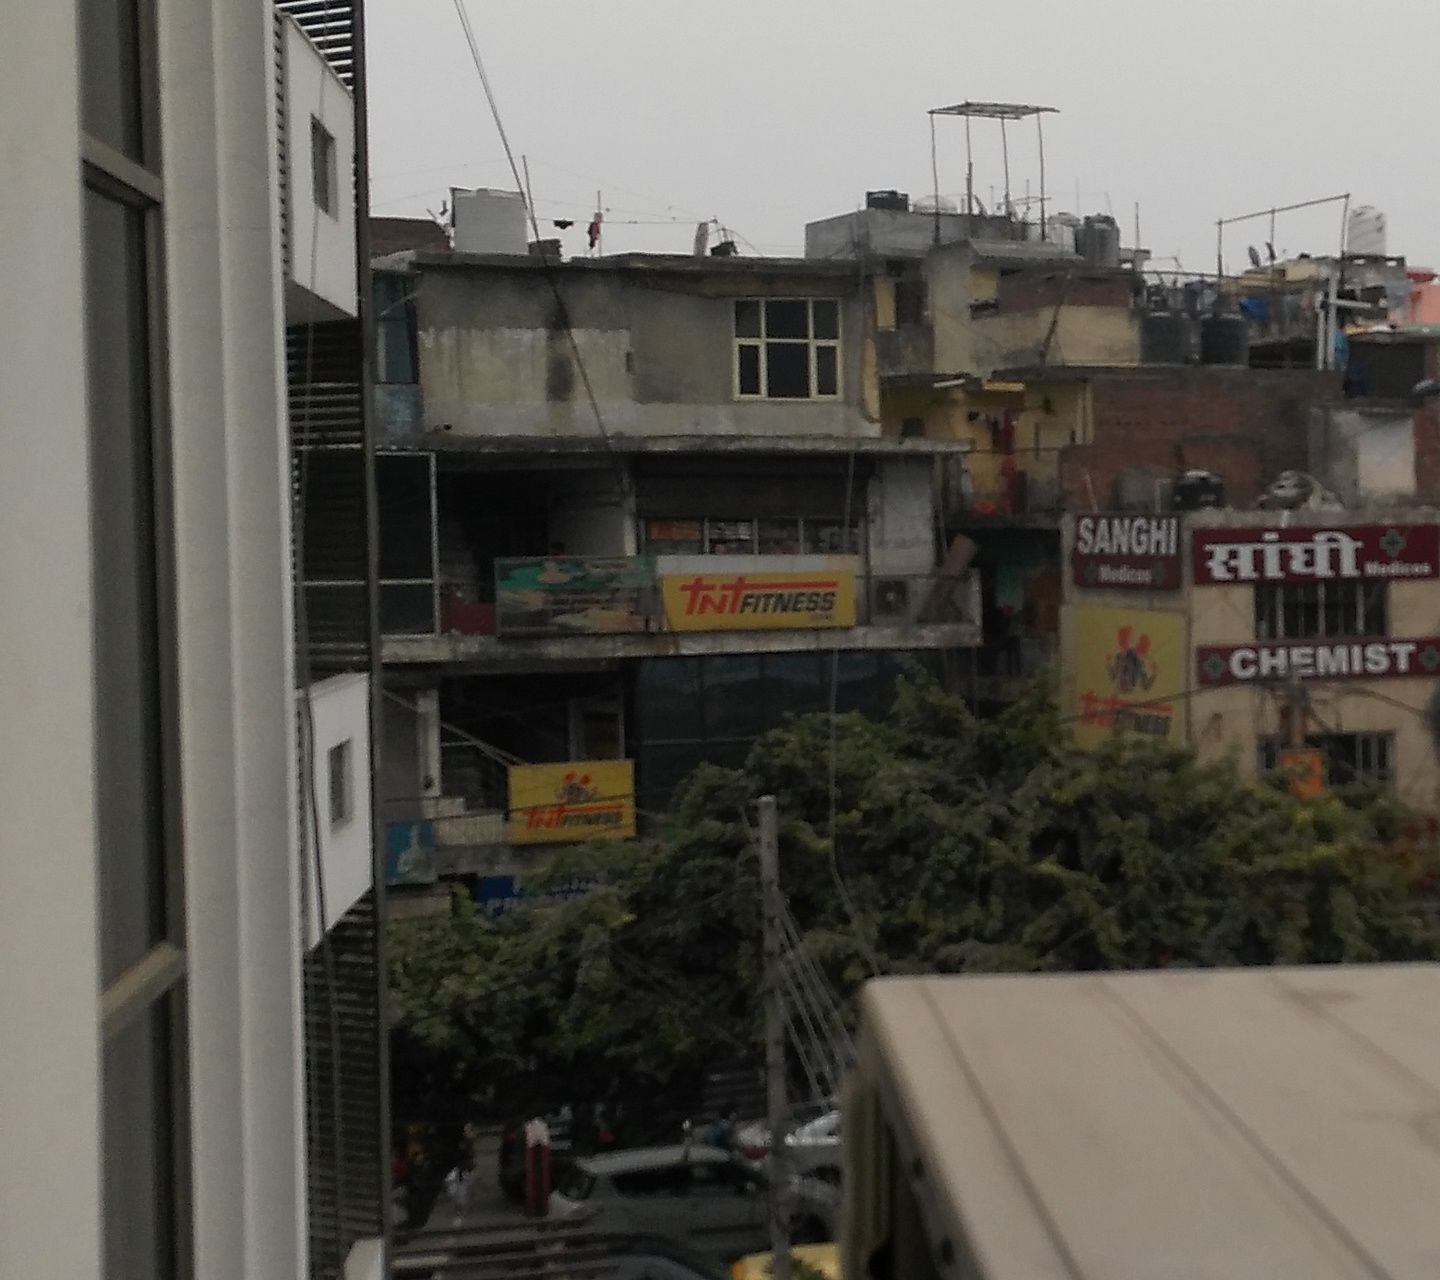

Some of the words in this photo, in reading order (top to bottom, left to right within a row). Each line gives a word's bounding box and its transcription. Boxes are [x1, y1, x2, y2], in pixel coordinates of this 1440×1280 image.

[1077, 516, 1177, 556] SANGHI
[1204, 530, 1363, 582] सांघी
[1364, 559, 1432, 578] Medicos
[740, 590, 838, 613] FITNESS
[1230, 641, 1417, 679] CHEMIST
